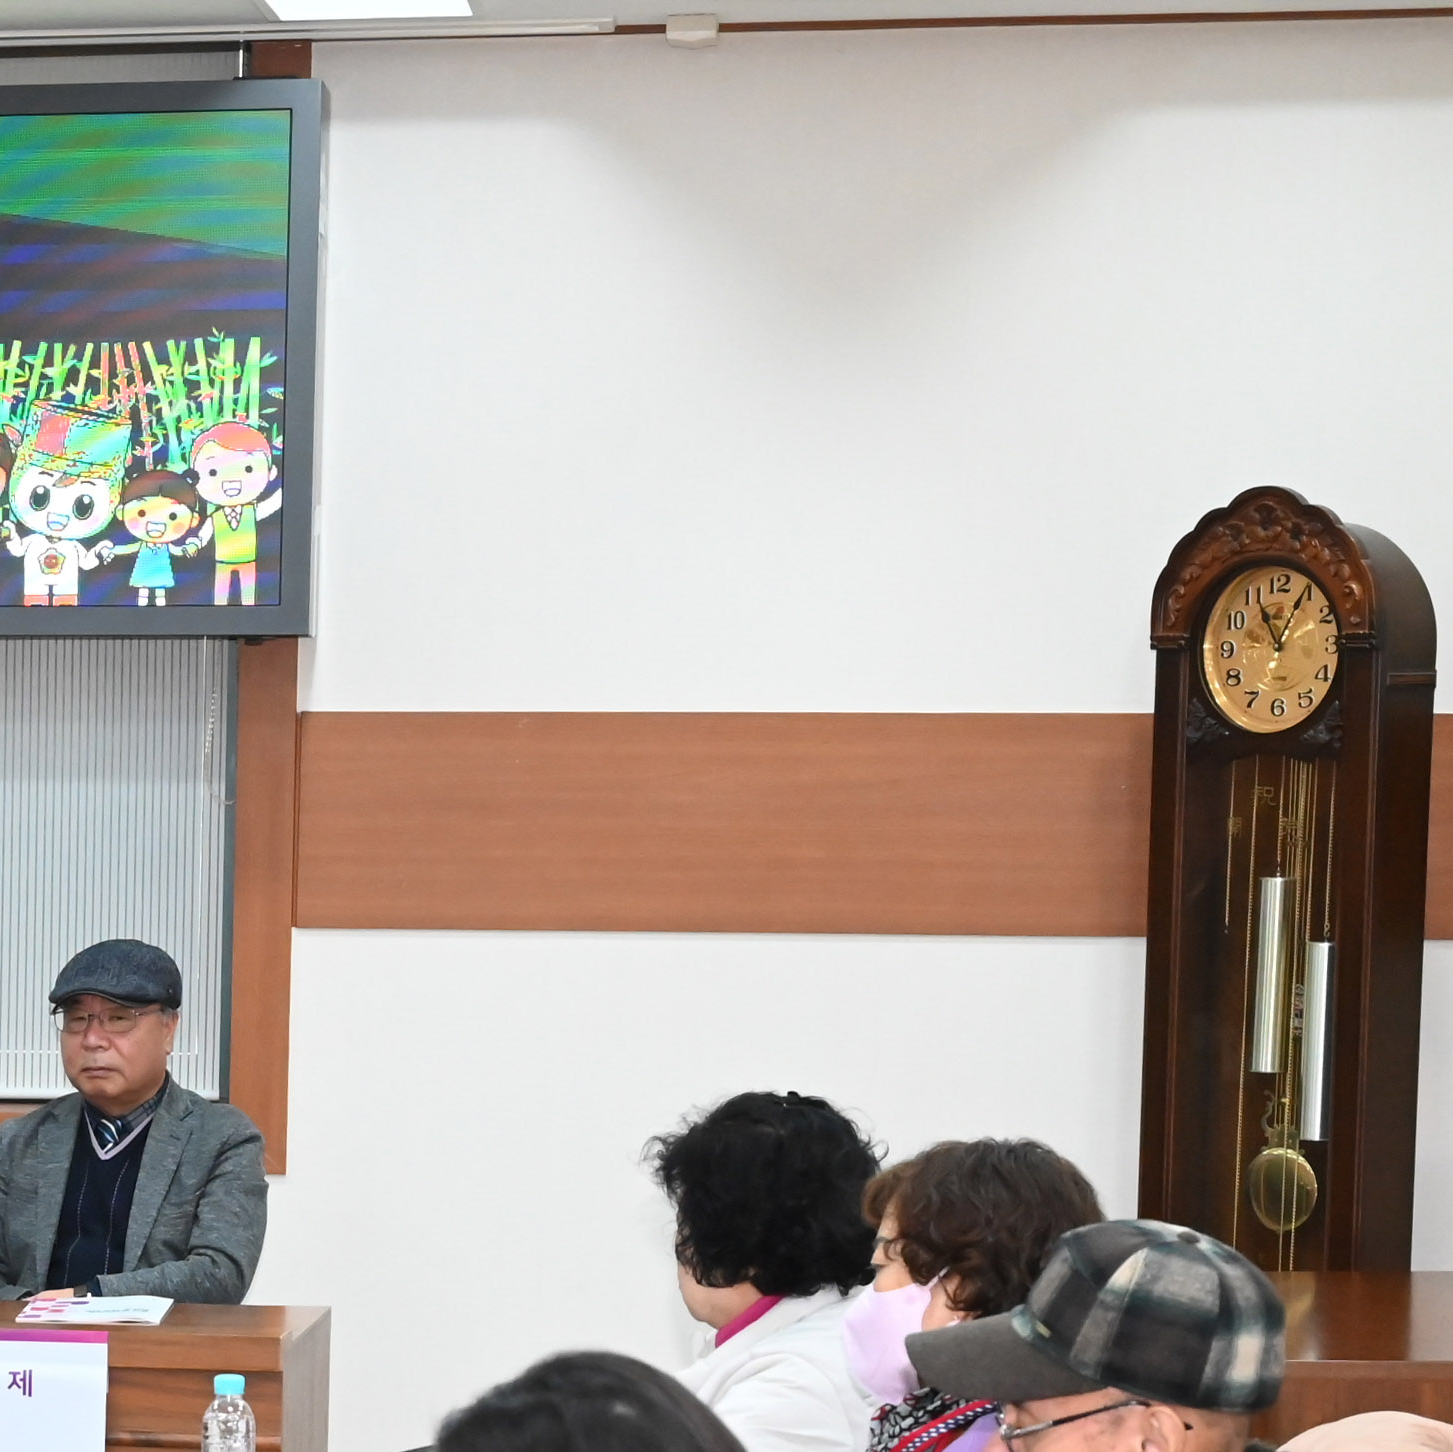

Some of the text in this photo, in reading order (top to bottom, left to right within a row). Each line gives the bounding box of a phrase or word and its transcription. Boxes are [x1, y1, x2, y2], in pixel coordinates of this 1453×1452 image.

[1268, 573, 1292, 595] 12
[1244, 585, 1263, 607] 11
[1226, 610, 1246, 631] 10
[1318, 605, 1335, 625] 2
[1220, 640, 1235, 659] 9
[1324, 634, 1340, 655] 3
[1225, 667, 1242, 687] 8
[1314, 663, 1332, 683] 4
[1243, 690, 1261, 709] 7
[1270, 697, 1287, 717] 6
[1297, 687, 1315, 709] 5
